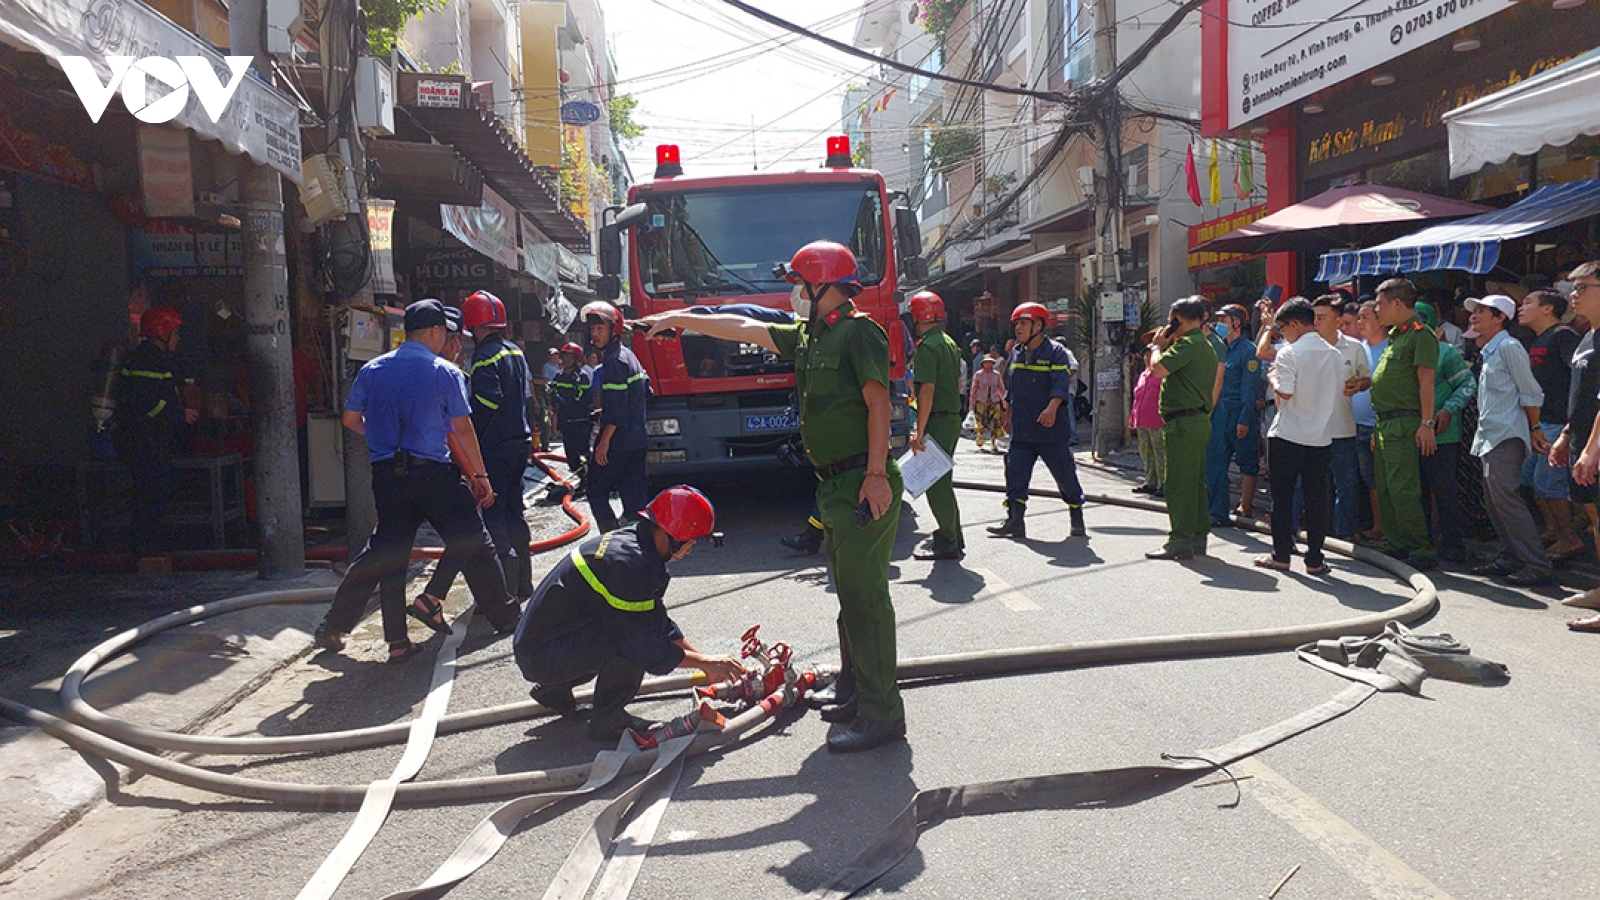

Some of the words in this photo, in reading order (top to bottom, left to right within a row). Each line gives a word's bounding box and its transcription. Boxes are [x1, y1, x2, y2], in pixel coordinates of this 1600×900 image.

[1251, 0, 1283, 26] COFFEE
[1405, 11, 1434, 34] 0703
[1436, 0, 1457, 20] 870
[1273, 61, 1287, 74] Duy
[747, 416, 801, 429] 43A-002
